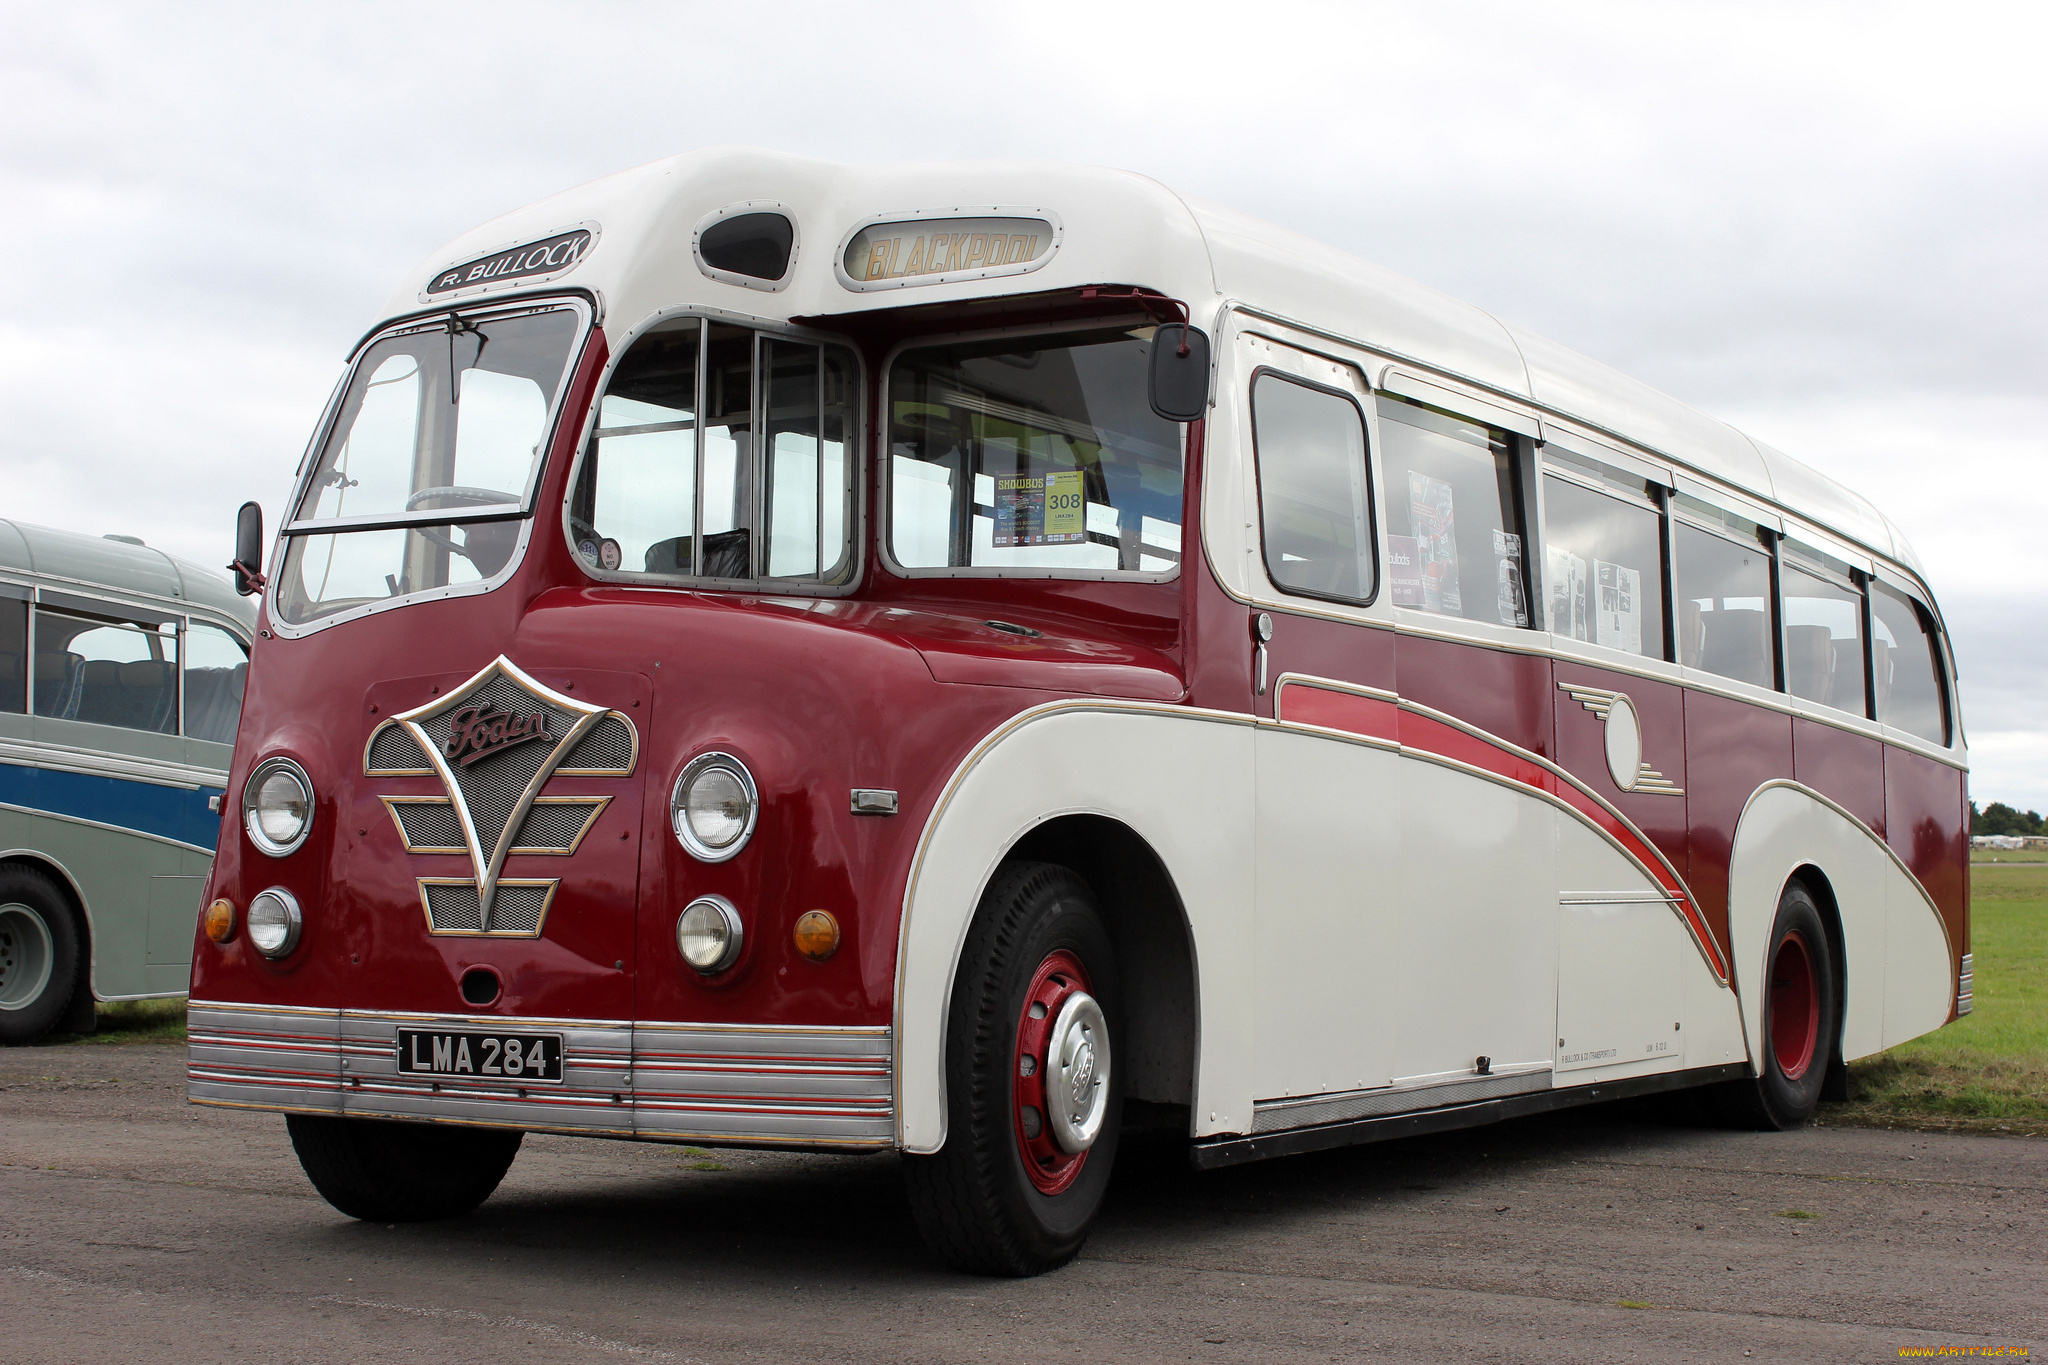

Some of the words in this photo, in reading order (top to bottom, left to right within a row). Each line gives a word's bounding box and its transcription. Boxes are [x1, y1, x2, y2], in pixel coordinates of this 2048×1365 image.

[439, 273, 461, 287] R.
[466, 235, 590, 282] BULLOCK
[864, 233, 1037, 281] BLACKPOOL
[999, 478, 1043, 490] SHOWBUS
[1049, 494, 1080, 509] 308
[442, 702, 553, 763] Foden
[411, 1035, 473, 1073] LMA
[481, 1038, 546, 1076] 284
[1565, 1054, 1580, 1063] BULLOCK
